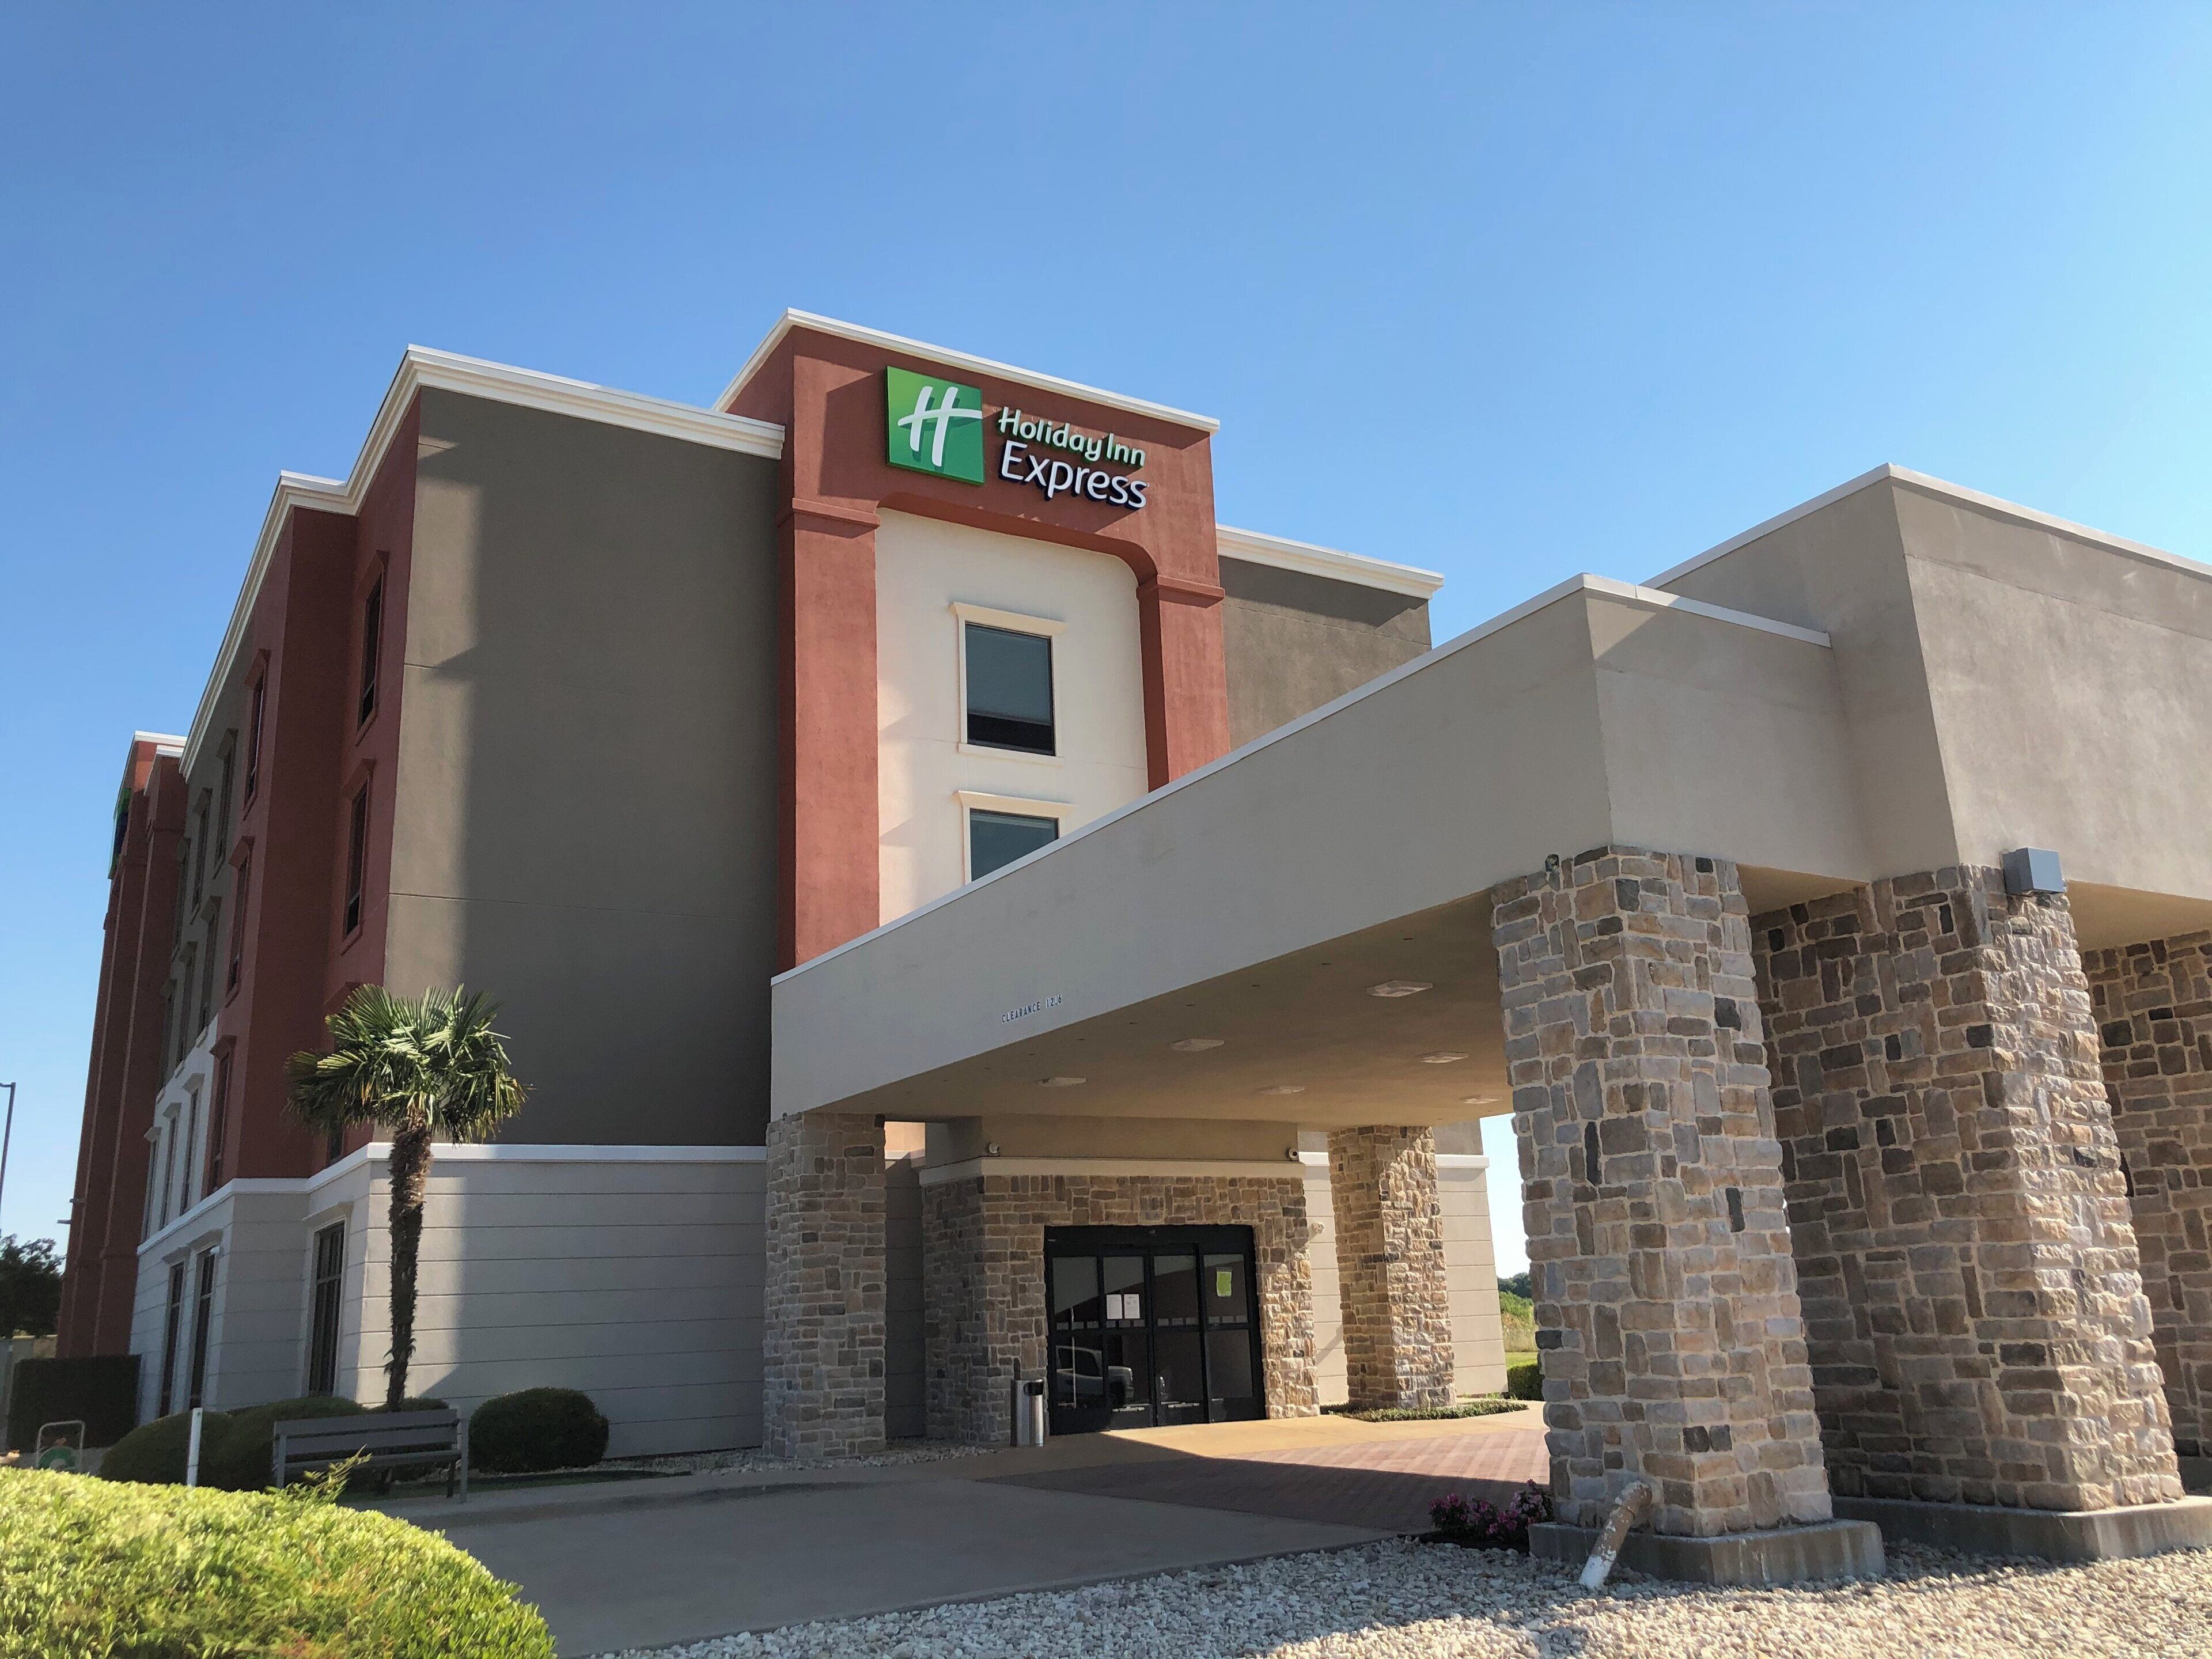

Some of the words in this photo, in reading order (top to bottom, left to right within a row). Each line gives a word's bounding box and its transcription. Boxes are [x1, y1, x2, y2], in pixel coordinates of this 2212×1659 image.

[998, 406, 1103, 461] Holiday
[1106, 432, 1146, 467] Inn
[1001, 439, 1147, 509] Express
[1002, 1001, 1040, 1023] CLEARANCE
